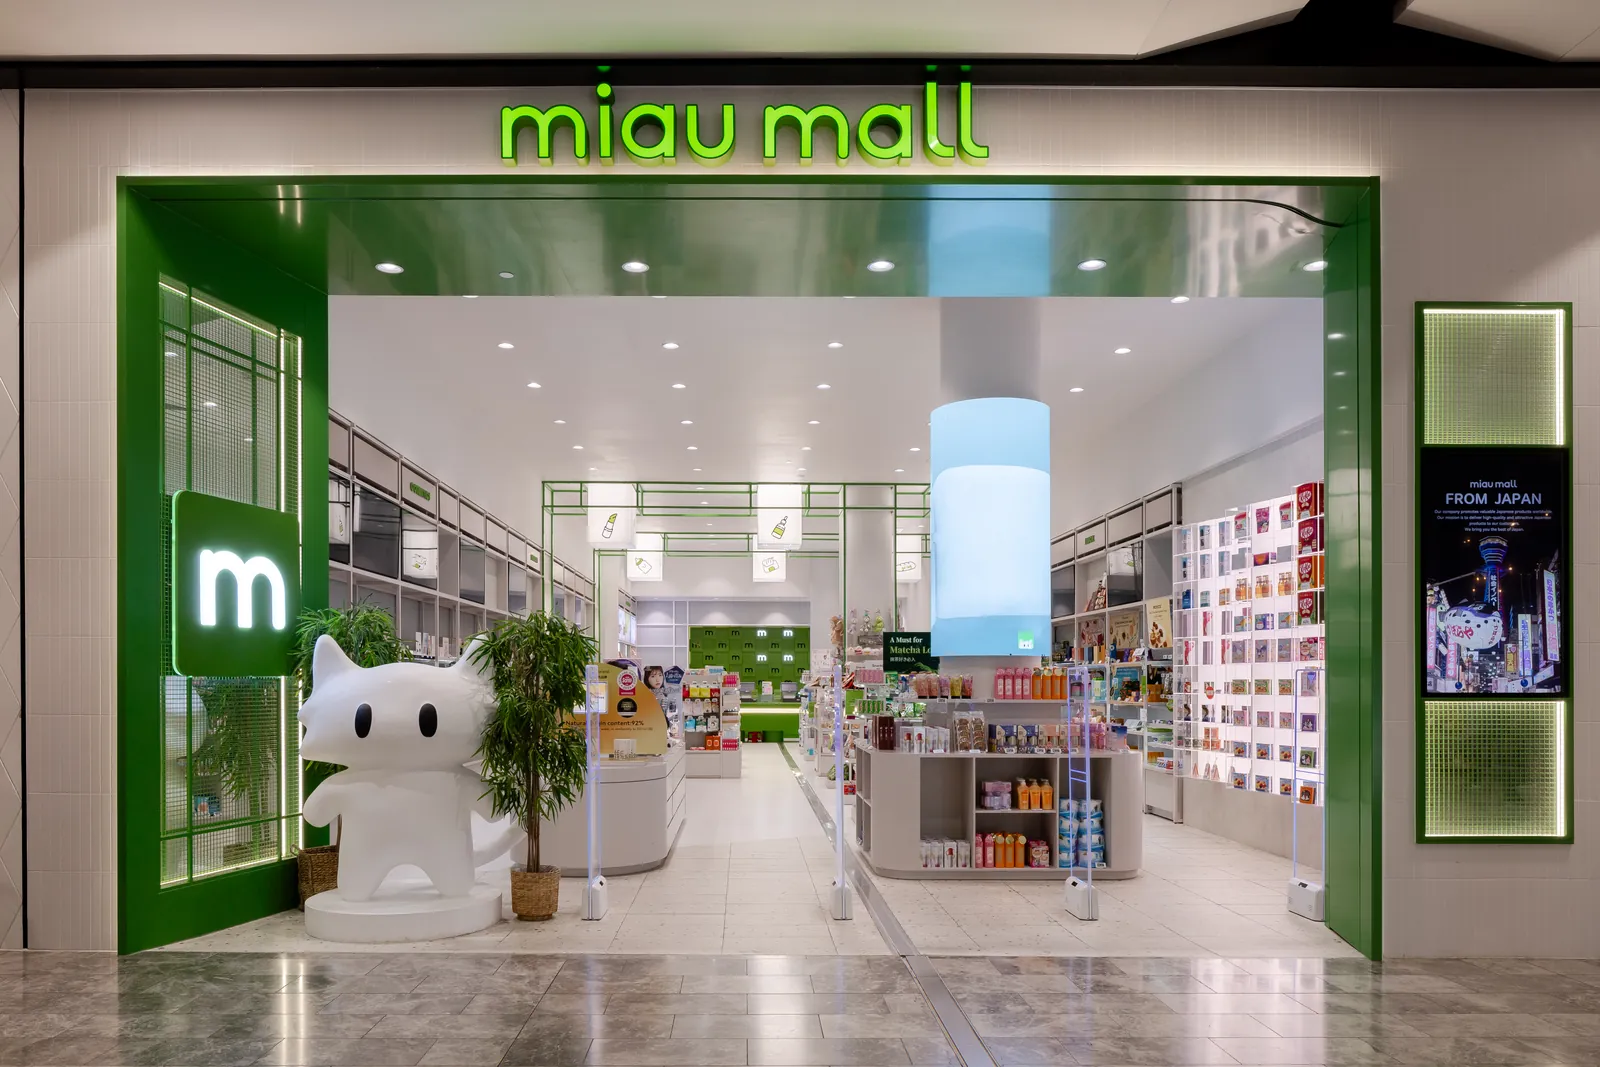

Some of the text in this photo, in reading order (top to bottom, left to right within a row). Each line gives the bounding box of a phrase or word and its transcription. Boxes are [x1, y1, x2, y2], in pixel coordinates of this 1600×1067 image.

[500, 81, 990, 163] miau mall
[1469, 479, 1518, 488] miau mall
[1445, 493, 1542, 505] FROM JAPAN
[199, 549, 286, 630] m
[890, 646, 920, 654] Matcha
